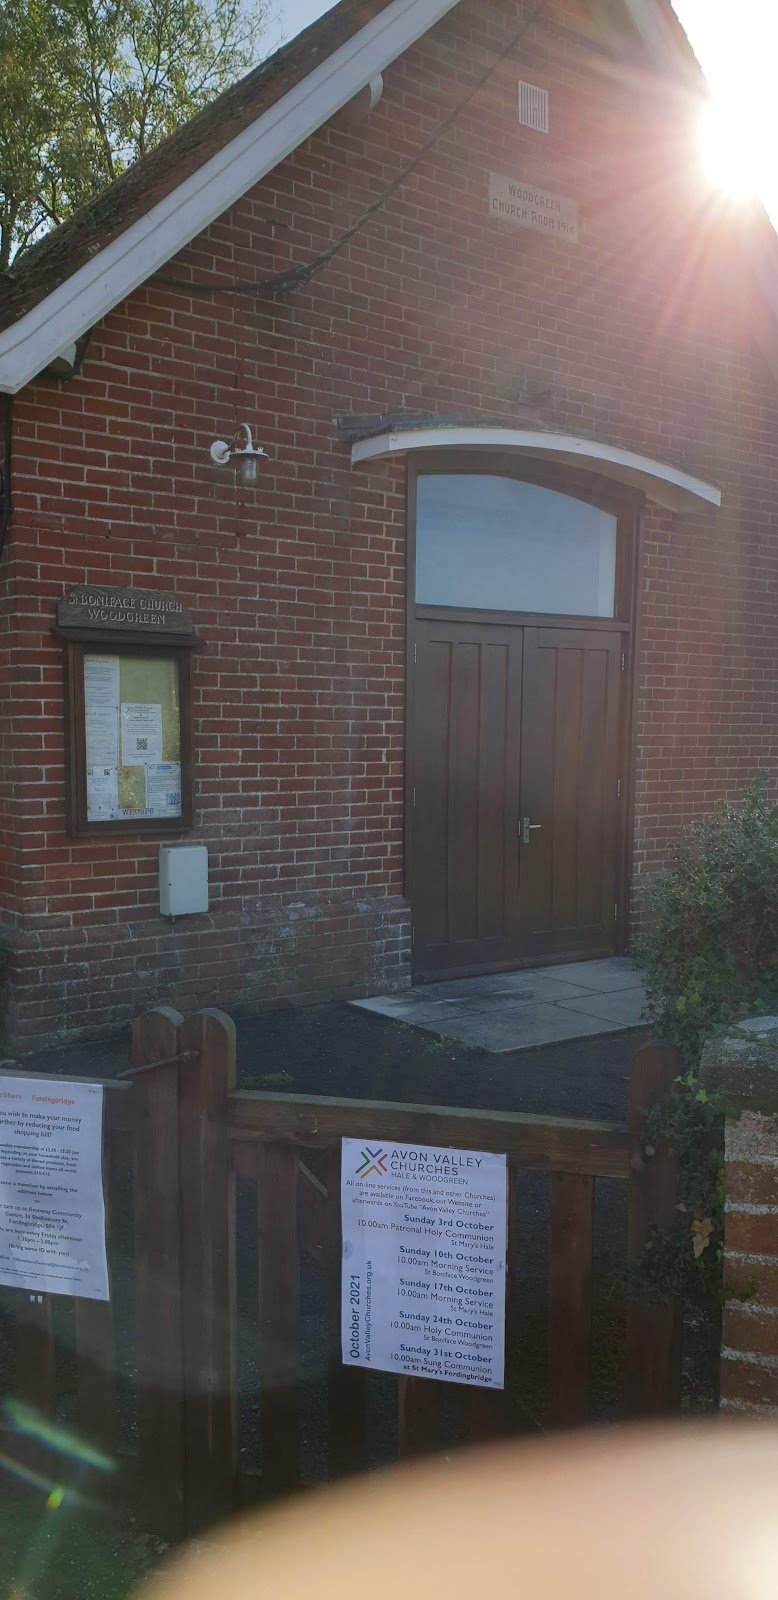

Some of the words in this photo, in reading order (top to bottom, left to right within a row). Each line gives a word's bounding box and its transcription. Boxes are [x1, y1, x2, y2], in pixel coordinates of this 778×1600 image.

[508, 183, 561, 213] WOODGREEN
[492, 198, 527, 219] CHURCH
[531, 210, 555, 229] ROOM
[80, 594, 136, 609] BONIFACE
[140, 599, 183, 613] CHURCH
[88, 609, 166, 625] WOODGREEN
[14, 1129, 39, 1138] shopping
[26, 1122, 51, 1130] reducing
[390, 1150, 428, 1162] AVON
[434, 1154, 483, 1168] VALLEY
[390, 1161, 459, 1176] CHURCHES
[392, 1172, 410, 1180] HALE
[418, 1174, 468, 1185] WOODGREEN
[403, 1185, 419, 1193] (from
[446, 1190, 462, 1198] other
[464, 1192, 496, 1201] Churches)
[352, 1197, 383, 1206] afterwards
[393, 1201, 418, 1210] YouTube
[438, 1207, 455, 1215] Valley
[448, 1199, 473, 1207] Website
[358, 1220, 389, 1230] 10.00am
[390, 1222, 422, 1234] Patronal
[424, 1228, 443, 1237] Holy
[446, 1230, 494, 1242] Communion
[404, 1214, 435, 1226] Sunday
[438, 1218, 453, 1227] 3rd
[456, 1220, 495, 1231] October
[400, 1246, 431, 1257] Sunday
[434, 1250, 452, 1260] 10th
[456, 1253, 495, 1265] October
[398, 1256, 429, 1267] 10.00am
[431, 1260, 463, 1273] Morning
[466, 1264, 494, 1275] Service
[432, 1270, 458, 1279] Boniface
[458, 1274, 494, 1284] Woodgreen
[350, 1275, 361, 1305] 2021
[400, 1278, 431, 1290] Sunday
[434, 1283, 453, 1292] 17th
[456, 1286, 494, 1297] October
[397, 1288, 428, 1300] 10.00am
[430, 1293, 463, 1305] Morning
[465, 1298, 494, 1309] Service
[365, 1260, 374, 1361] AvonValleyChurches.org.uk
[400, 1311, 430, 1323] Sunday
[433, 1316, 452, 1325] 24th
[456, 1318, 494, 1330] October
[350, 1308, 360, 1359] October
[390, 1320, 422, 1332] 10.00am
[424, 1325, 442, 1335] Holy
[444, 1328, 493, 1341] Communion
[432, 1336, 457, 1345] Boniface
[458, 1340, 493, 1350] Woodgreen
[390, 1352, 422, 1364] 10.00am
[424, 1358, 442, 1368] Sung
[444, 1360, 493, 1374] Communion
[400, 1344, 431, 1356] Sunday
[434, 1349, 452, 1358] 31st
[454, 1352, 493, 1363] October
[444, 1370, 493, 1382] Fordingbridge
